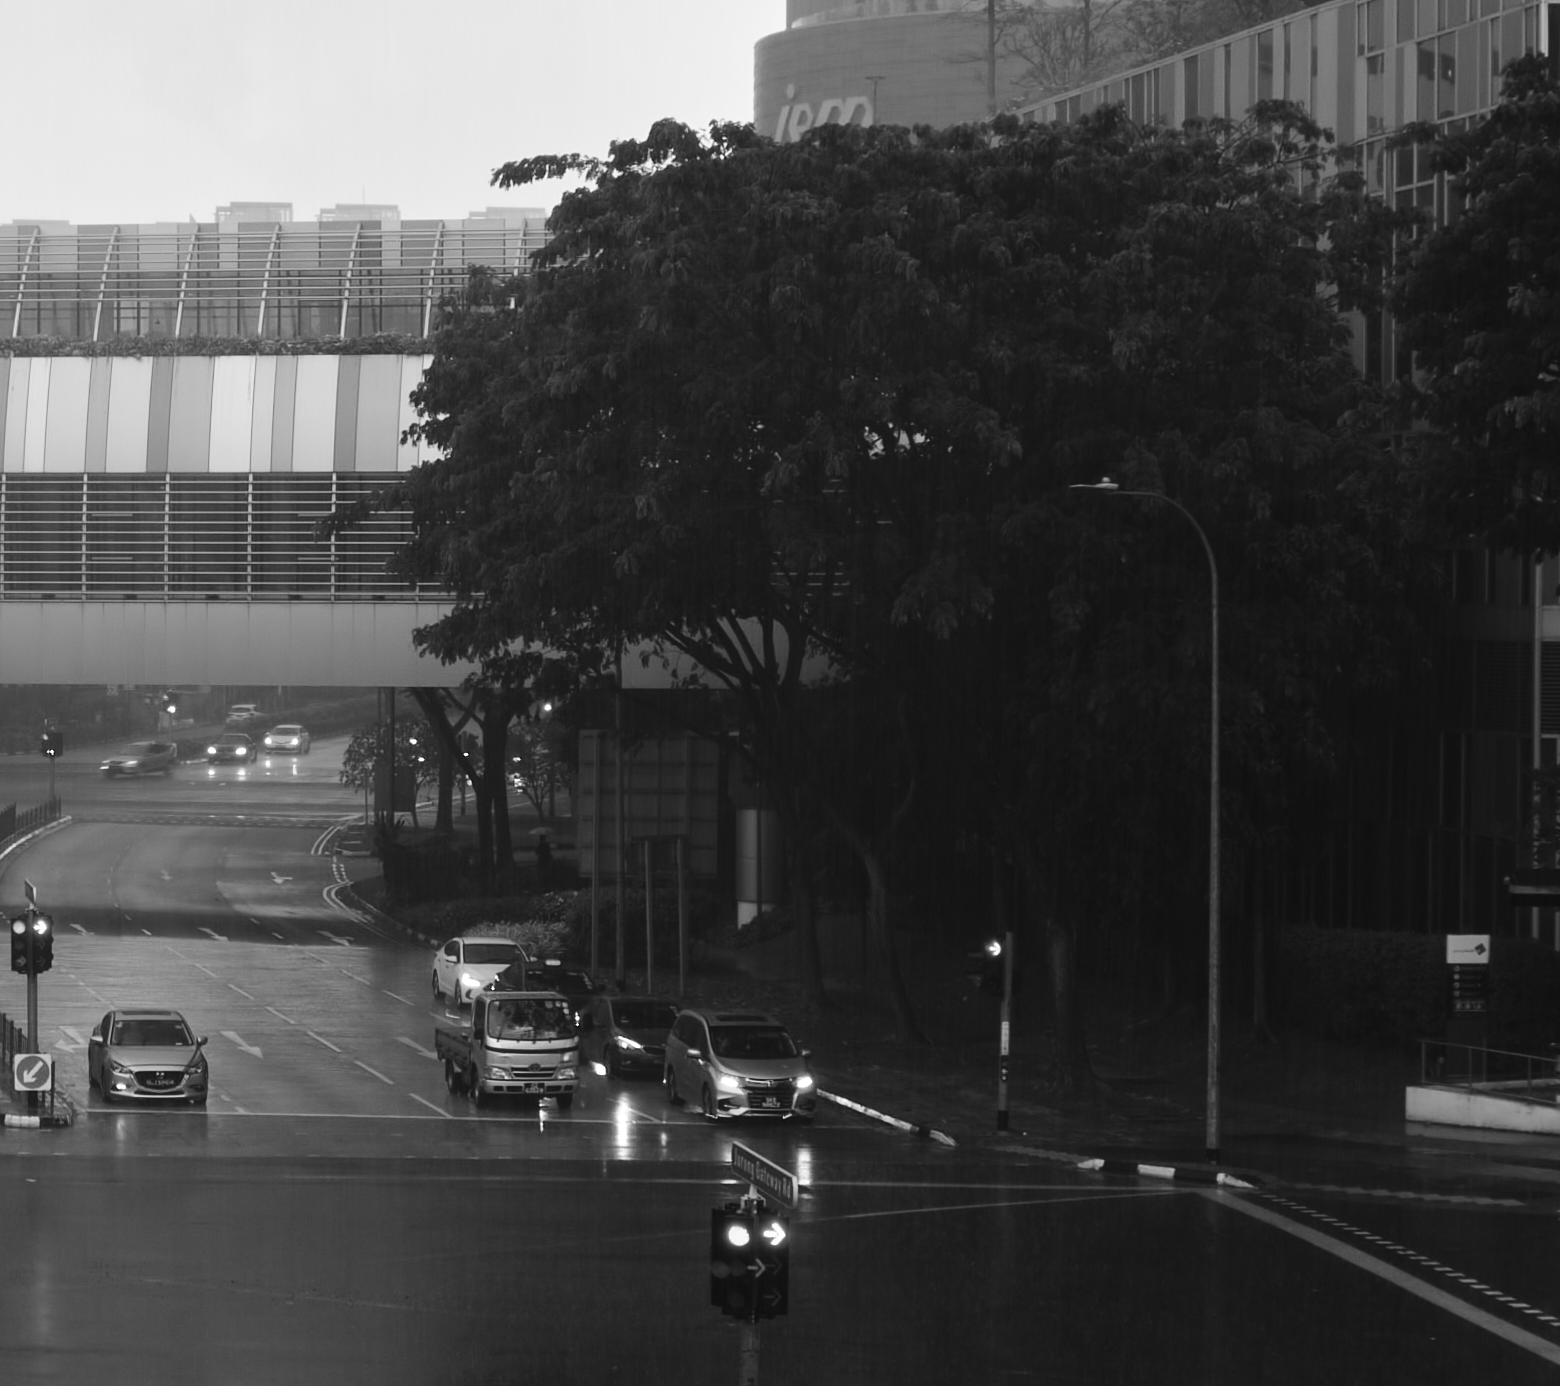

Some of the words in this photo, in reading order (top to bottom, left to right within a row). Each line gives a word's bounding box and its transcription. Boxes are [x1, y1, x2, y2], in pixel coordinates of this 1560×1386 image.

[734, 1147, 755, 1181] Jurong
[756, 1160, 782, 1198] Gateway
[782, 1177, 792, 1200] Rd
